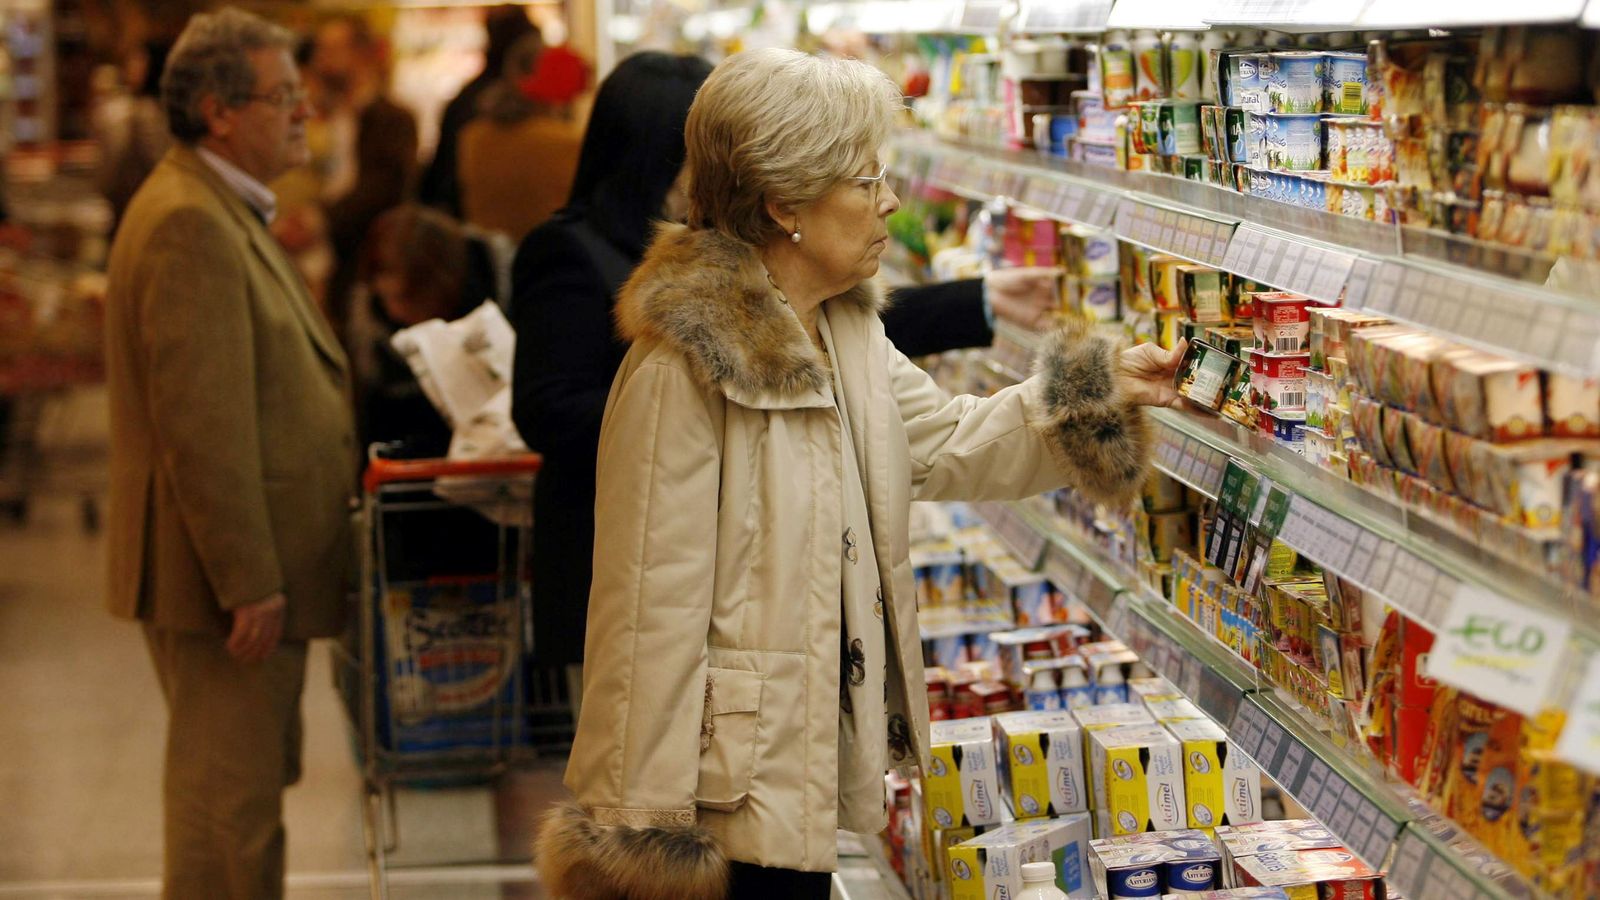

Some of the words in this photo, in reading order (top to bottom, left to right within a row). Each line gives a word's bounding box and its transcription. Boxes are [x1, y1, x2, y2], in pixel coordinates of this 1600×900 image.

[1448, 614, 1546, 656] ECO
[971, 779, 987, 818] Actimel
[1060, 766, 1073, 807] Actimel
[1160, 782, 1173, 825] Actimel
[1235, 776, 1248, 820] Actimel
